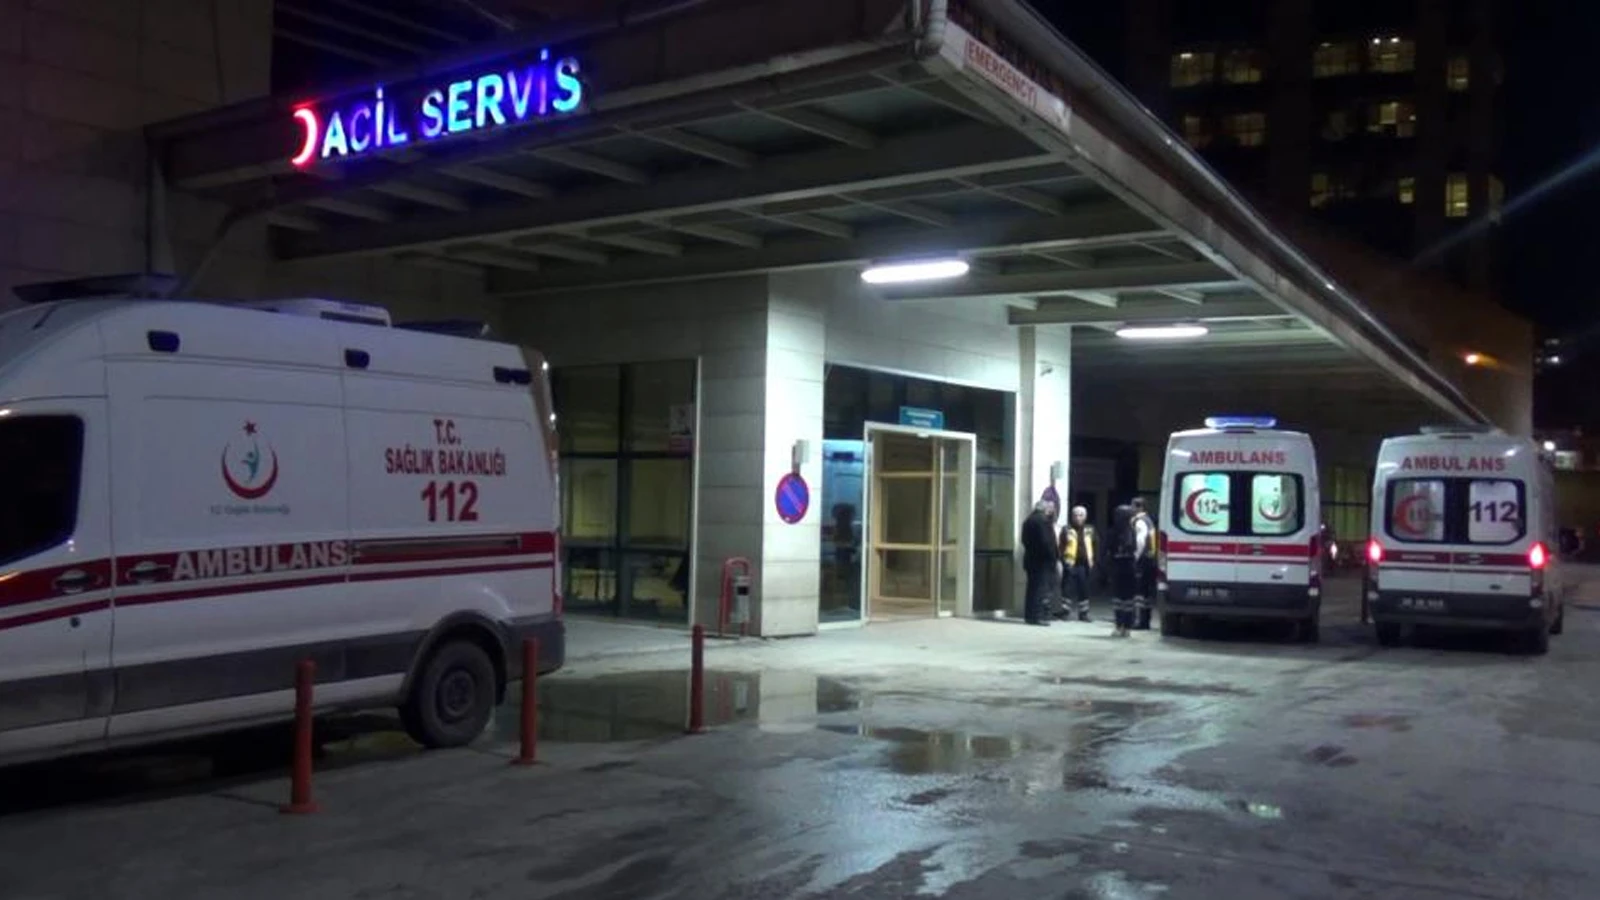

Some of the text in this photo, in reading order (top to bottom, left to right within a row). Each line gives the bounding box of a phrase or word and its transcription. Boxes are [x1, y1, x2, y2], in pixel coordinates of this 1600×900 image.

[321, 48, 582, 158] ACİL SERVİS
[433, 419, 462, 445] T.C.
[385, 443, 506, 476] SAĞLIK BAKANLIĞI
[1189, 450, 1286, 465] AMBULANS
[1402, 456, 1506, 472] AMBULANS
[421, 480, 478, 522] 112
[1197, 499, 1218, 514] 112
[1469, 501, 1517, 523] 112
[172, 540, 348, 581] AMBULANS
